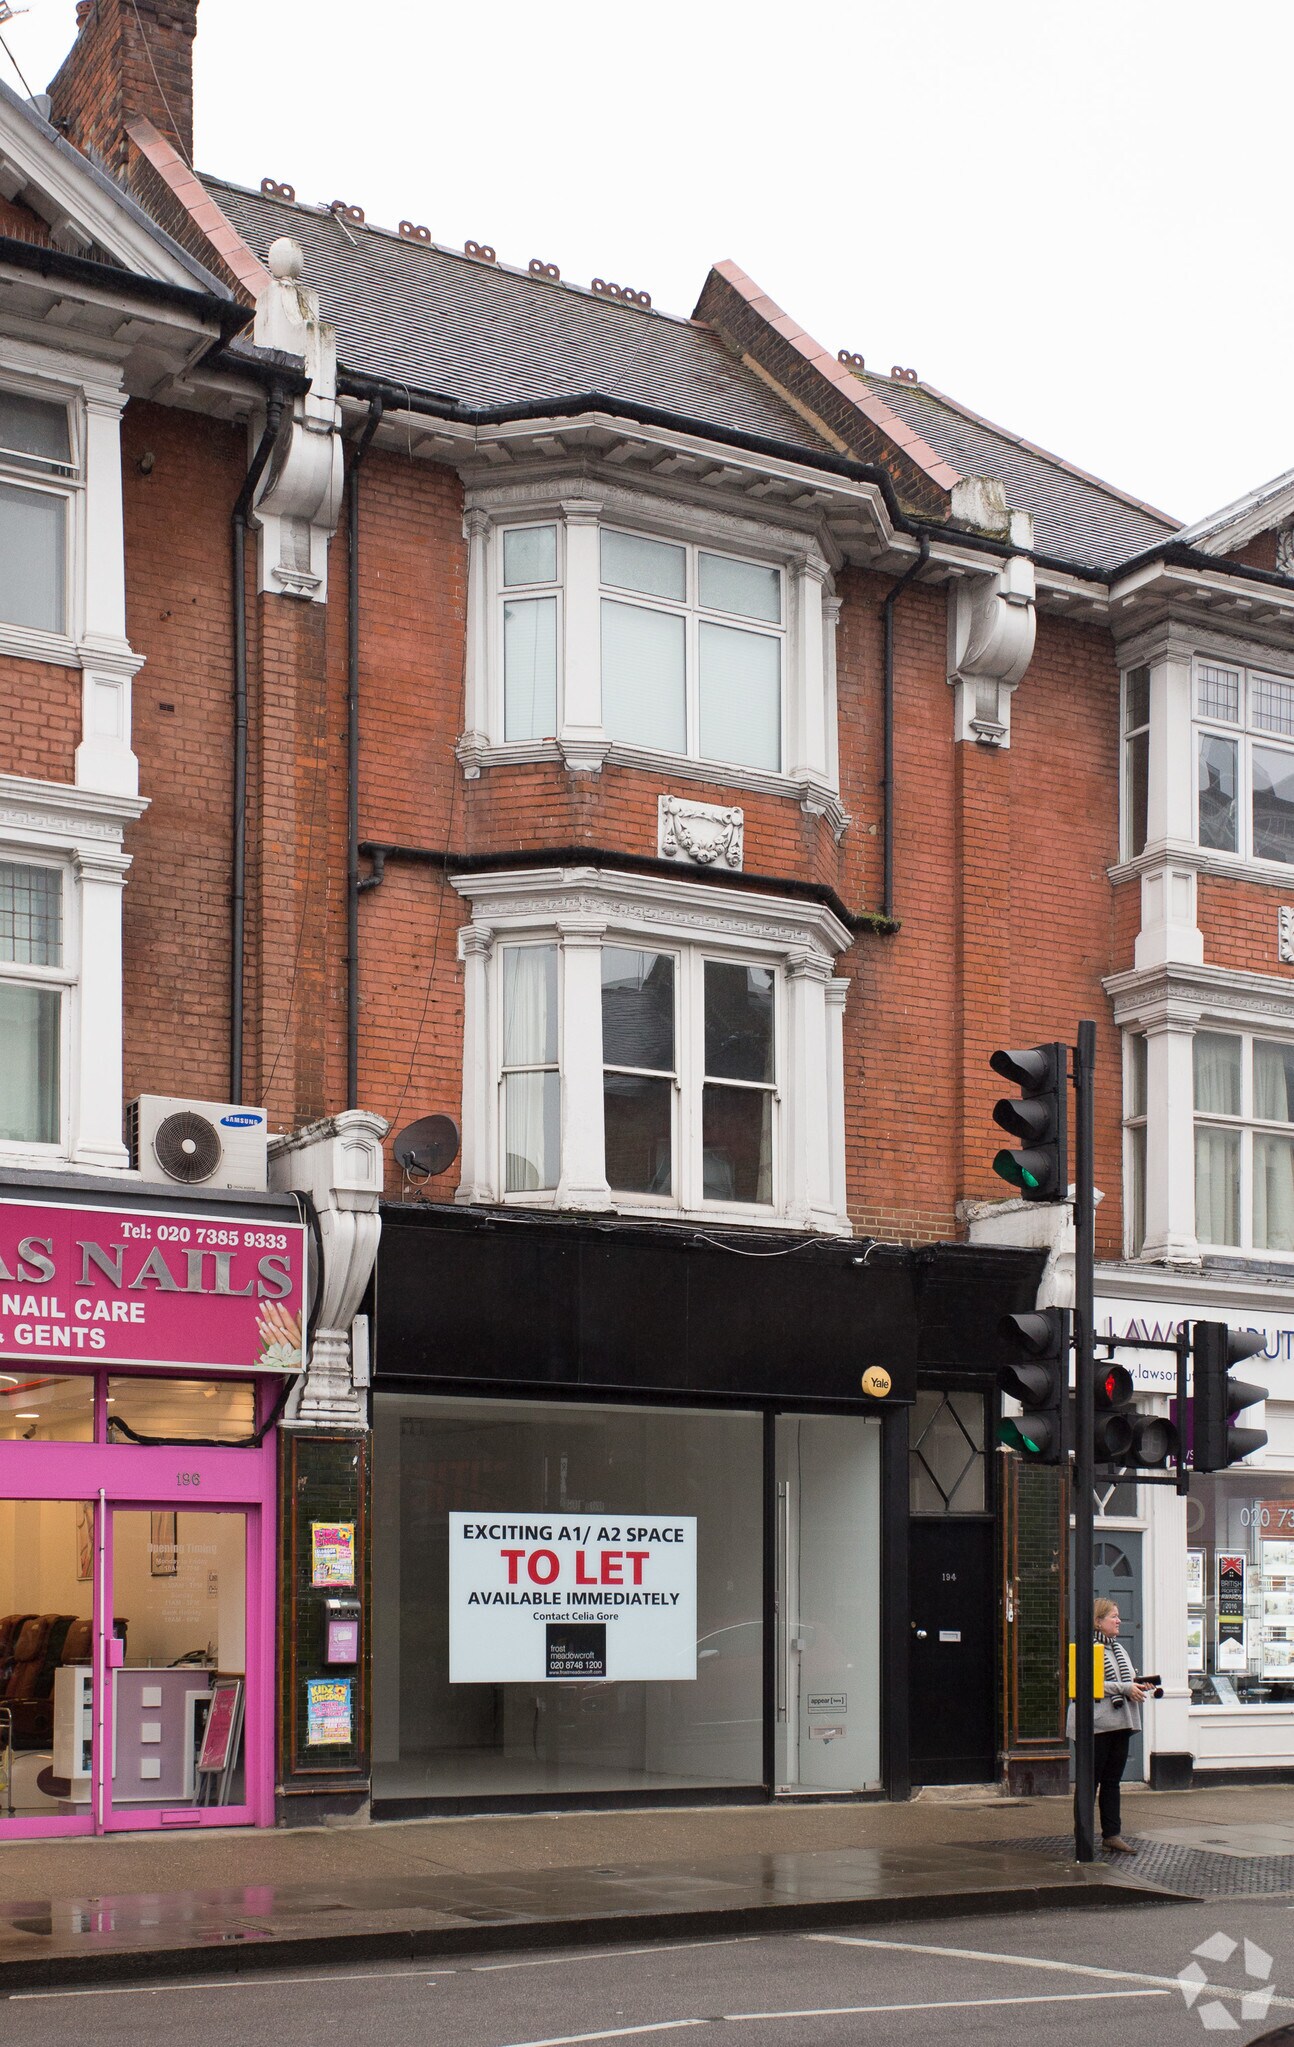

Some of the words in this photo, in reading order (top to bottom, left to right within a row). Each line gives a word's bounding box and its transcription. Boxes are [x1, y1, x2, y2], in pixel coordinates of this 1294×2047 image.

[225, 1116, 259, 1125] SAMSUNG
[121, 1222, 151, 1240] Tel:
[157, 1225, 190, 1242] 020
[196, 1228, 239, 1246] 7385
[244, 1232, 287, 1250] 9333
[75, 1241, 293, 1299] NAILS
[2, 1293, 66, 1319] NAIL
[74, 1298, 146, 1324] CARE
[14, 1323, 106, 1350] GENTS
[870, 1377, 889, 1389] Yale
[176, 1472, 201, 1486] 196
[1240, 1507, 1270, 1527] 020
[463, 1524, 552, 1541] EXCITING
[557, 1525, 592, 1545] A1/
[597, 1527, 621, 1542] A2
[626, 1527, 684, 1543] SPACE
[500, 1549, 560, 1585] TO
[575, 1550, 650, 1585] LET
[942, 1573, 957, 1582] 194
[467, 1591, 561, 1606] AVAILABLE
[566, 1592, 680, 1606] IMMEDIATELY
[533, 1611, 570, 1621] Contact
[572, 1612, 594, 1621] Celia
[596, 1612, 619, 1621] Gore
[550, 1644, 566, 1652] frost
[550, 1651, 595, 1660] meadowcroft
[550, 1661, 564, 1670] 020
[565, 1660, 584, 1669] 8748
[585, 1660, 603, 1669] 1200
[310, 1684, 335, 1696] KIDZ
